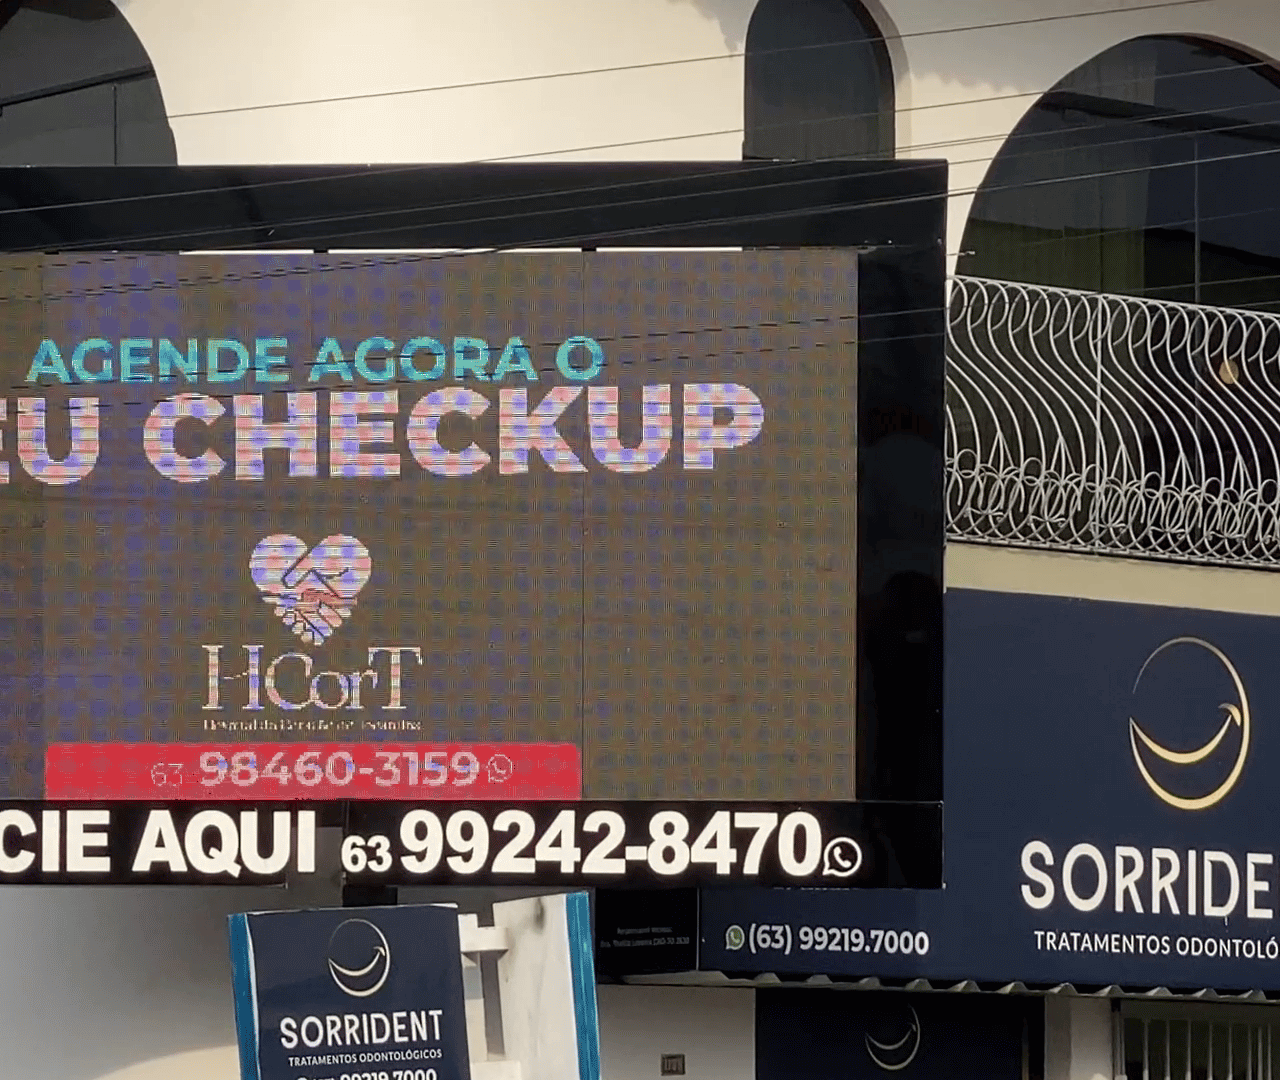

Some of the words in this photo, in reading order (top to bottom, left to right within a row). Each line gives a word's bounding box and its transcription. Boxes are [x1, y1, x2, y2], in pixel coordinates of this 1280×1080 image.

[24, 337, 288, 385] AGENDE
[312, 335, 540, 384] AGORA
[555, 335, 603, 381] O
[143, 382, 765, 483] CHECKUP
[201, 645, 422, 709] HCorT
[151, 762, 184, 786] 63
[200, 752, 479, 786] 98460-3159
[132, 808, 316, 880] AQUI
[341, 834, 392, 873] 63
[399, 809, 822, 876] 99242-8470
[749, 923, 792, 954] (63)
[799, 926, 929, 955] 99219.7000
[1034, 930, 1171, 957] TRATAMENTOS
[280, 1009, 443, 1049] SORRIDENT
[288, 1054, 357, 1067] TRATAMENTOS
[359, 1048, 442, 1064] ODONTOLÓGICOS
